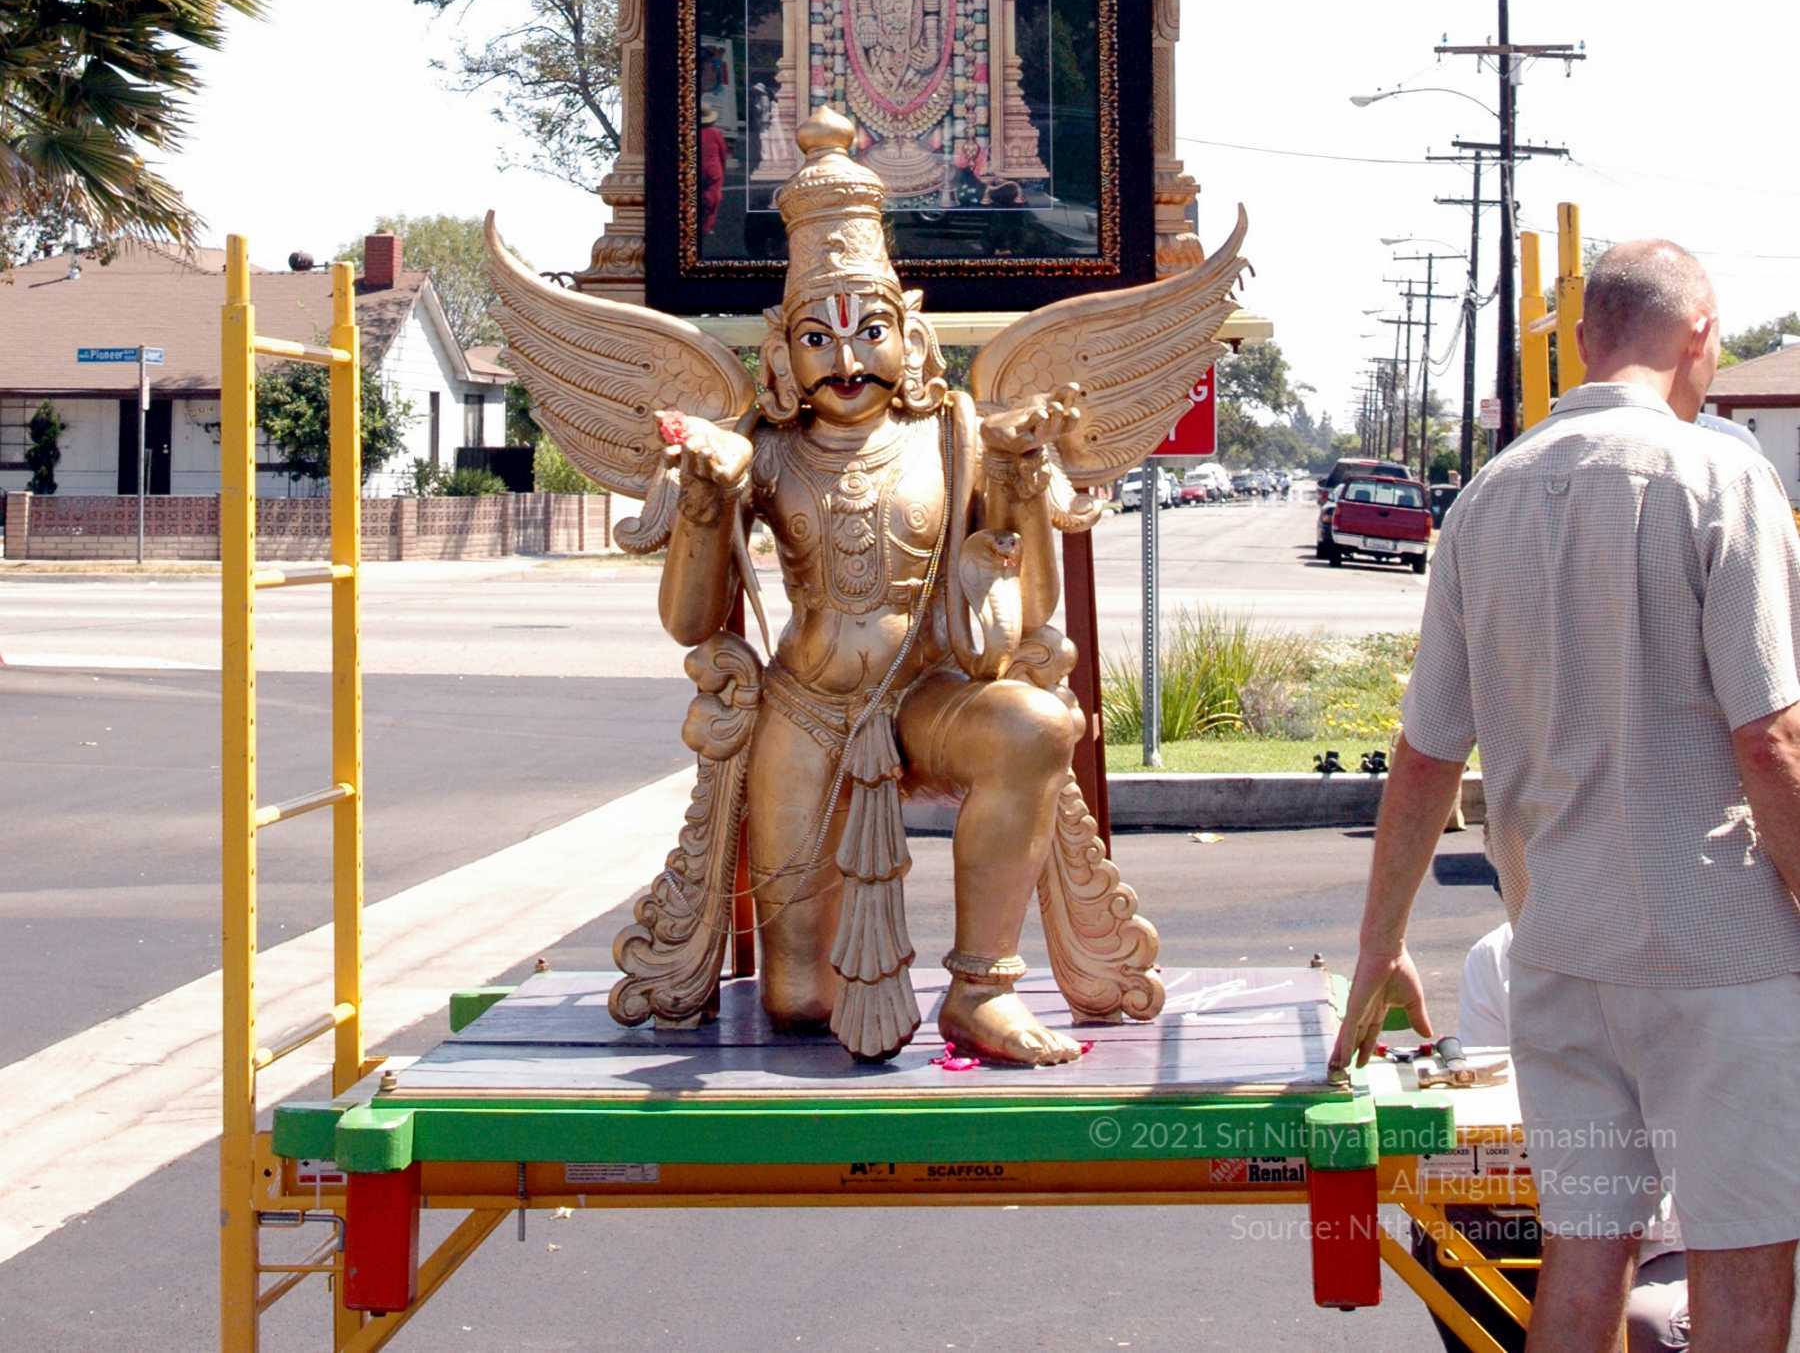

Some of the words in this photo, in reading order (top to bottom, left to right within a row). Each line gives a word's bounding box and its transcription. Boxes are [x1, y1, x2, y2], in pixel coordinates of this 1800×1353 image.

[90, 349, 123, 360] Pioneer
[927, 1165, 1004, 1177] SCAFFOLD
[1248, 1164, 1304, 1182] Rental
